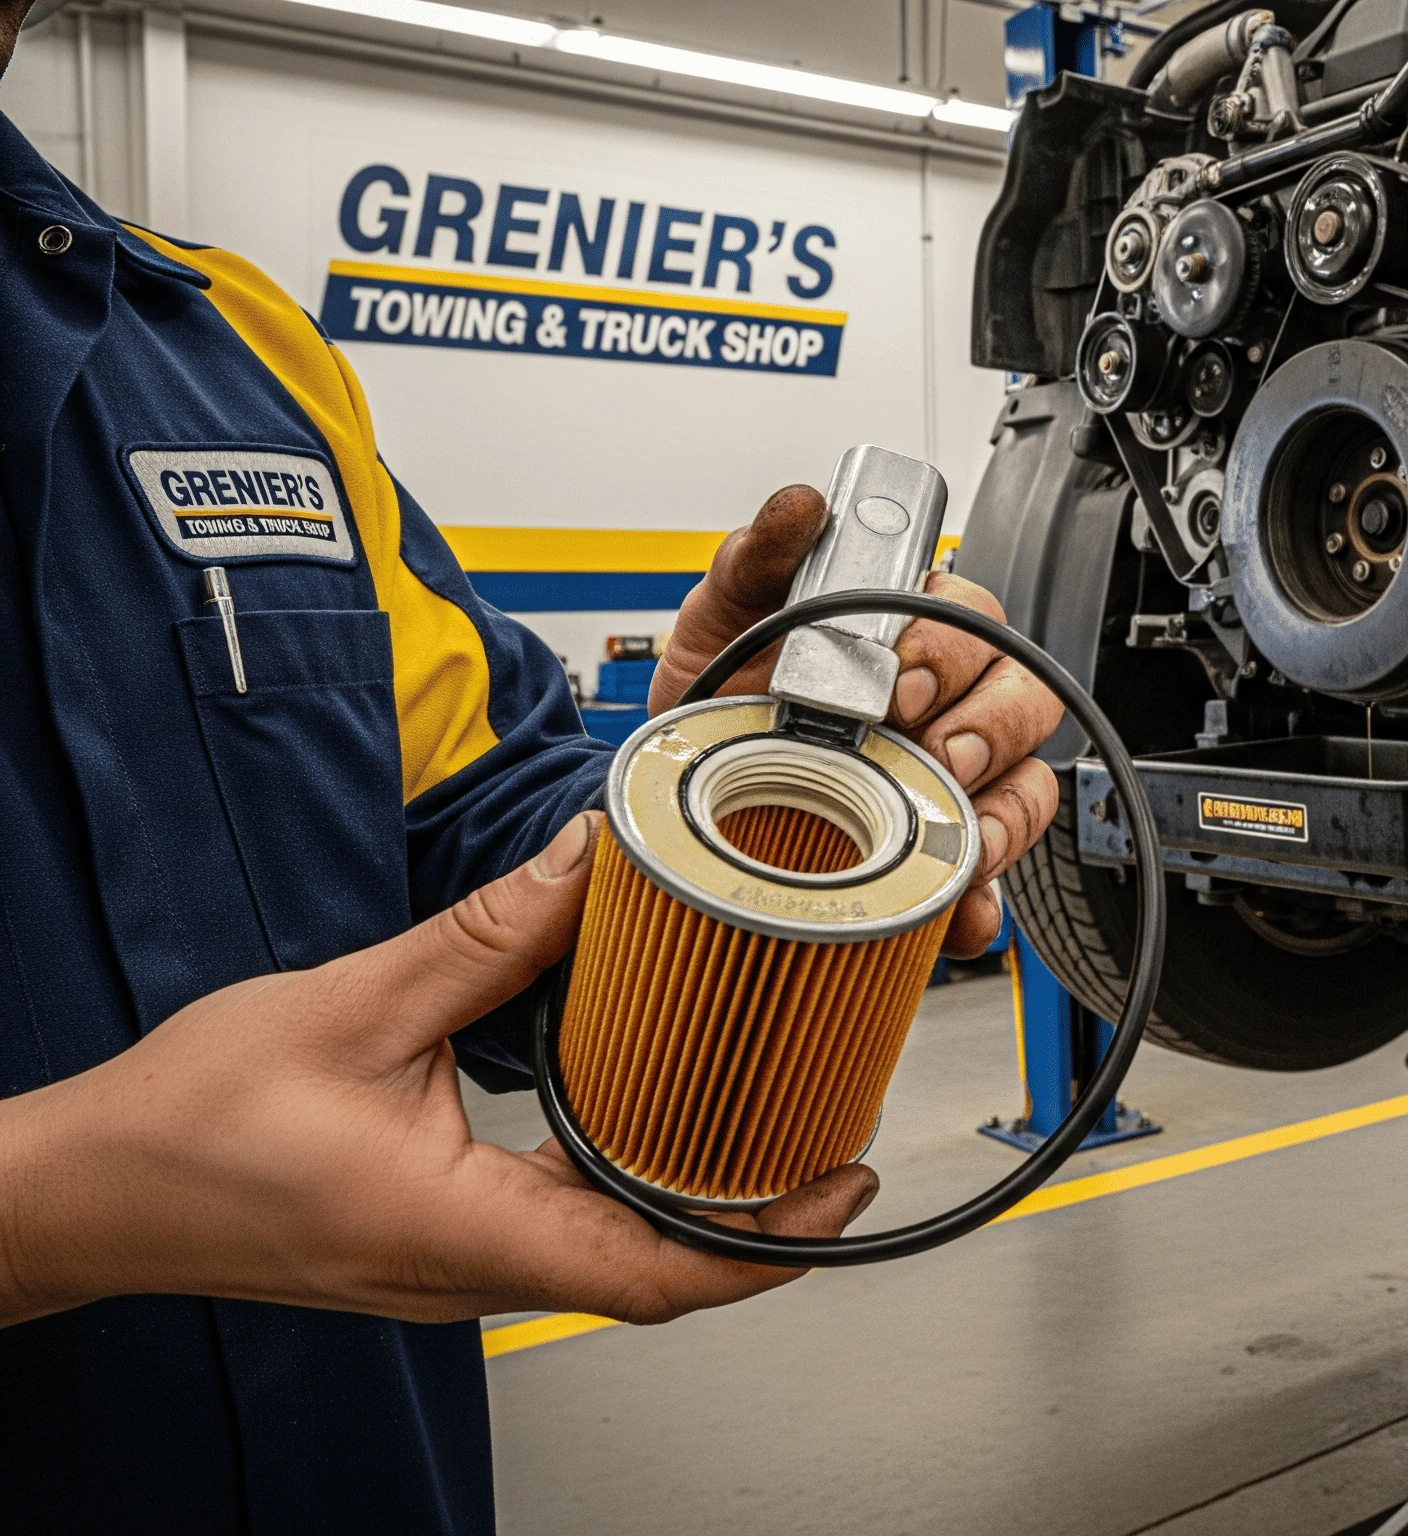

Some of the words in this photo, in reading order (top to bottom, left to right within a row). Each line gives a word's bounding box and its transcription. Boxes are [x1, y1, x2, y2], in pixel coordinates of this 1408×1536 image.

[339, 163, 838, 300] GRENIER'S
[350, 287, 526, 346] TOWING
[535, 310, 567, 348] &
[579, 309, 714, 360] TRUCK
[720, 321, 824, 368] SHOP
[160, 469, 324, 511] GRENIER'S
